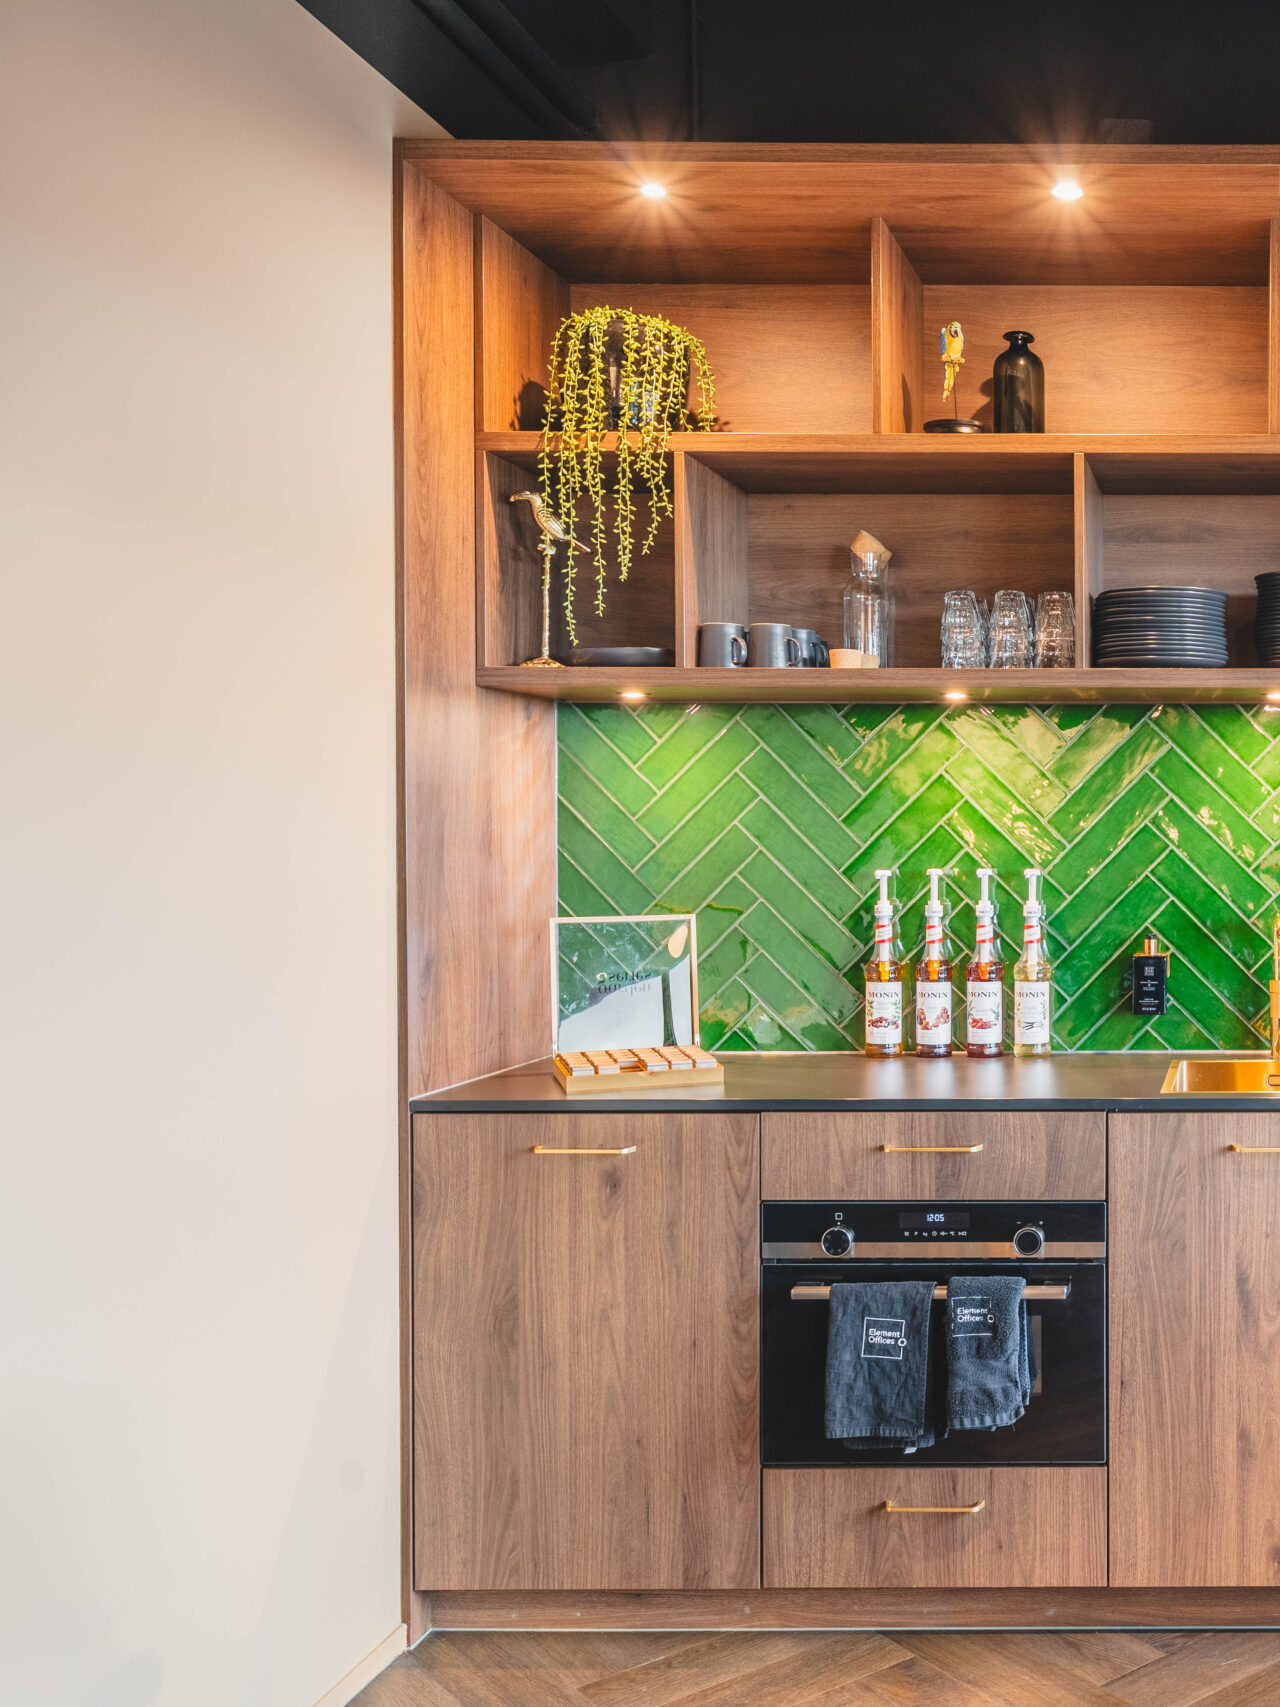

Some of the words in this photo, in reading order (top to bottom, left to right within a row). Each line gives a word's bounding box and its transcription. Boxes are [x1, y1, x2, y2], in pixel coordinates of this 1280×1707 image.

[957, 1307, 988, 1315] Element
[868, 1328, 900, 1338] Element
[868, 1335, 895, 1345] Offices
